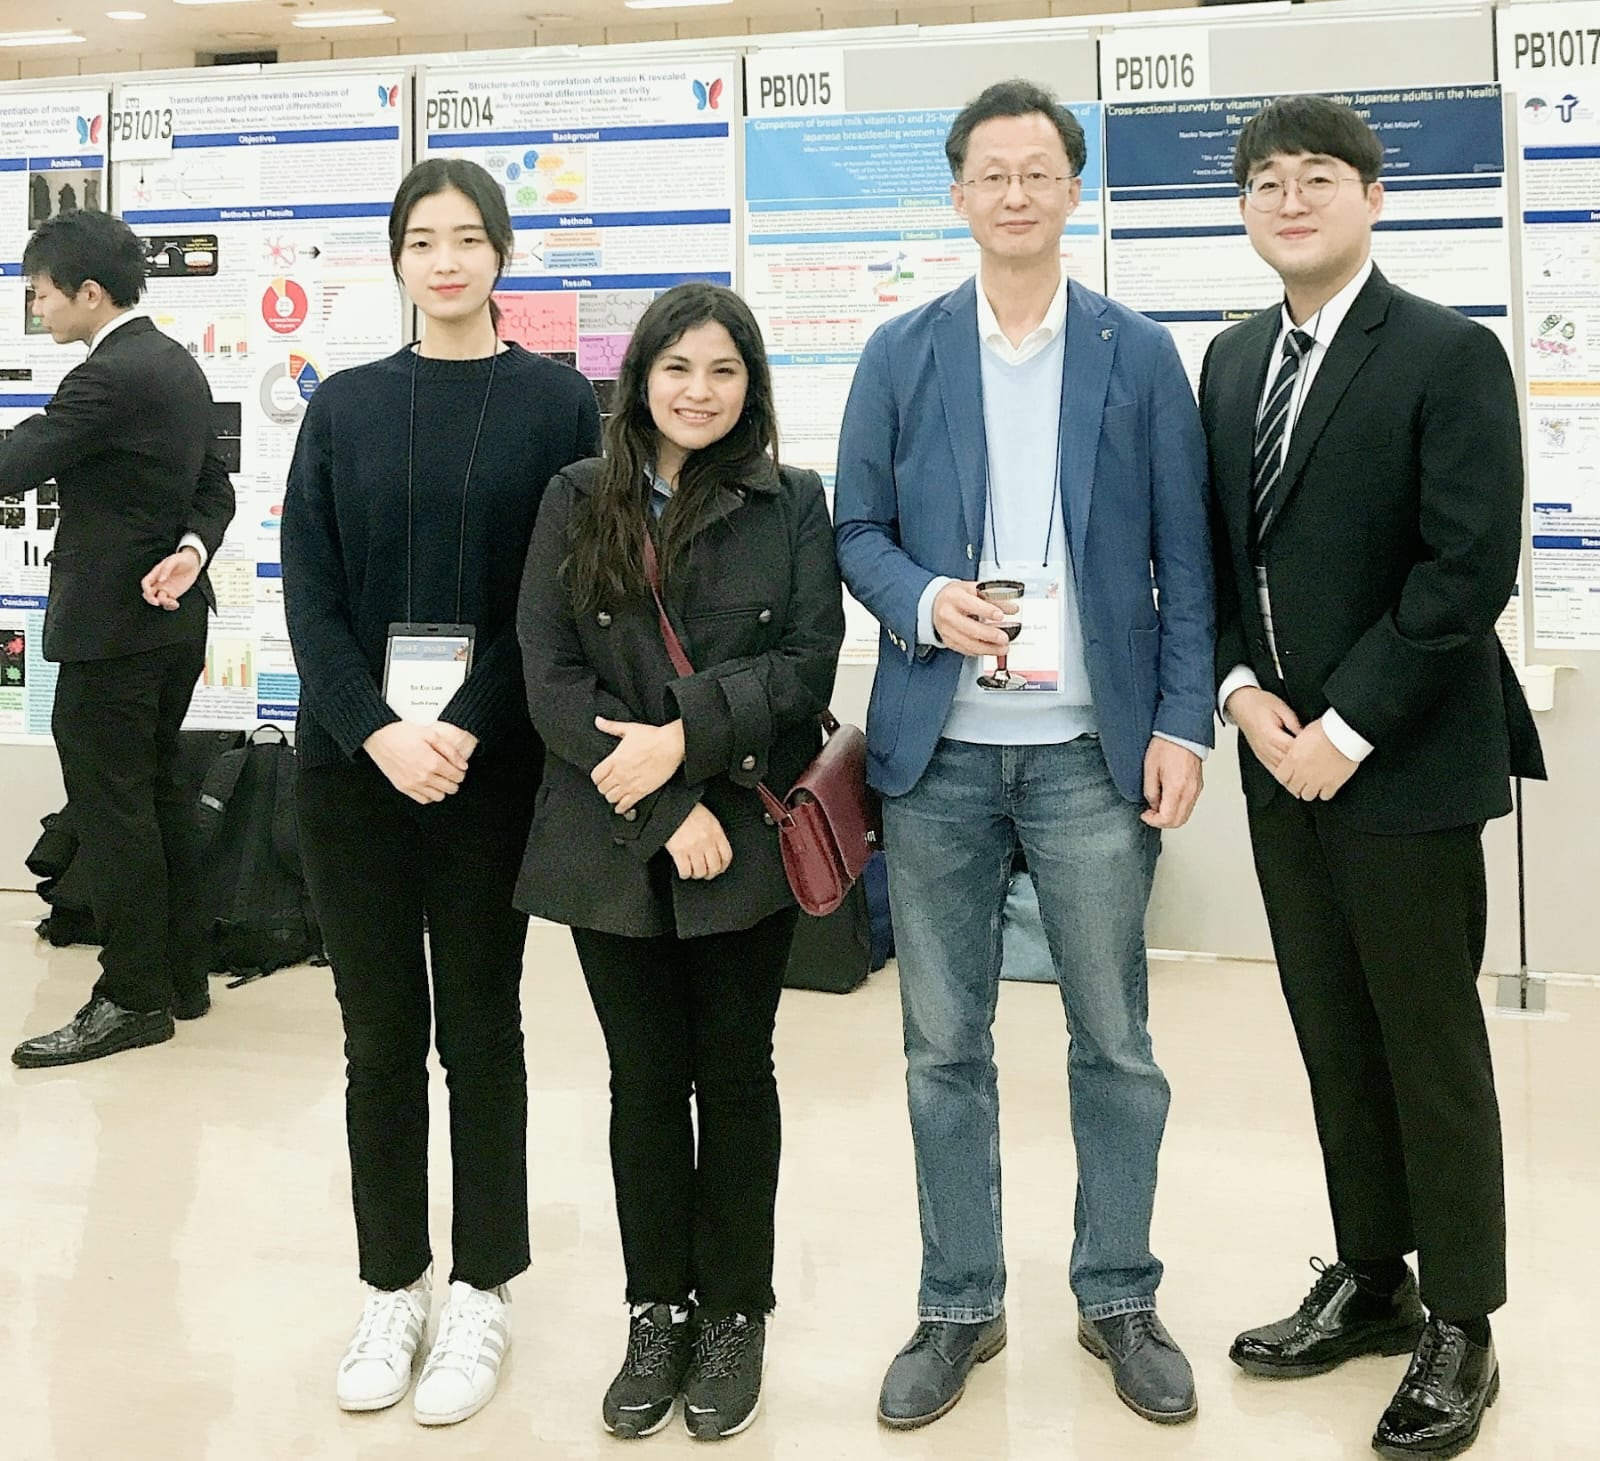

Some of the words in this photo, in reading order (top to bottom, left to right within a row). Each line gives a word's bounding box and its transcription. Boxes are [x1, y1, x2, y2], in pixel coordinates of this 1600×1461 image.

[1514, 29, 1600, 69] PB1017
[543, 77, 590, 87] correlation
[593, 75, 602, 84] of
[604, 74, 636, 84] vitamin
[639, 73, 647, 82] K
[648, 72, 686, 82] revealed
[1115, 53, 1194, 91] PB1016
[168, 95, 224, 105] Transcriptome
[227, 93, 258, 103] analysis
[261, 91, 290, 100] reveals
[292, 89, 338, 99] mechanism
[340, 88, 349, 97] of
[502, 92, 513, 101] by
[515, 90, 552, 99] neuronal
[555, 86, 617, 98] differentiation
[620, 85, 651, 96] activity
[760, 72, 831, 108] PB1015
[249, 103, 284, 112] neuronal
[286, 101, 342, 111] differentiation
[1108, 102, 1176, 116] Cross-sectional
[1178, 103, 1208, 114] survey
[1210, 100, 1225, 111] for
[1226, 99, 1261, 110] vitamin
[1355, 93, 1400, 105] Japanese
[1402, 90, 1432, 102] adults
[1435, 89, 1445, 100] in
[1447, 88, 1464, 99] the
[1466, 86, 1498, 98] health
[52, 105, 80, 113] mouse
[426, 96, 494, 129] PB1014
[112, 108, 173, 141] PB1013
[754, 119, 803, 130] Comparison
[806, 119, 815, 128] of
[816, 118, 842, 127] breast
[844, 116, 861, 126] milk
[863, 114, 896, 125] vitamin
[898, 114, 905, 124] D
[907, 114, 923, 124] and
[1226, 114, 1241, 125] life
[552, 131, 600, 144] Background
[803, 133, 840, 143] Japanese
[843, 128, 901, 141] breastfeeding
[902, 129, 935, 138] women
[936, 128, 945, 136] in
[51, 158, 82, 168] Animals
[220, 210, 250, 219] Methods
[252, 209, 266, 218] and
[267, 208, 294, 218] Results
[559, 216, 594, 227] Methods
[562, 278, 592, 289] Results
